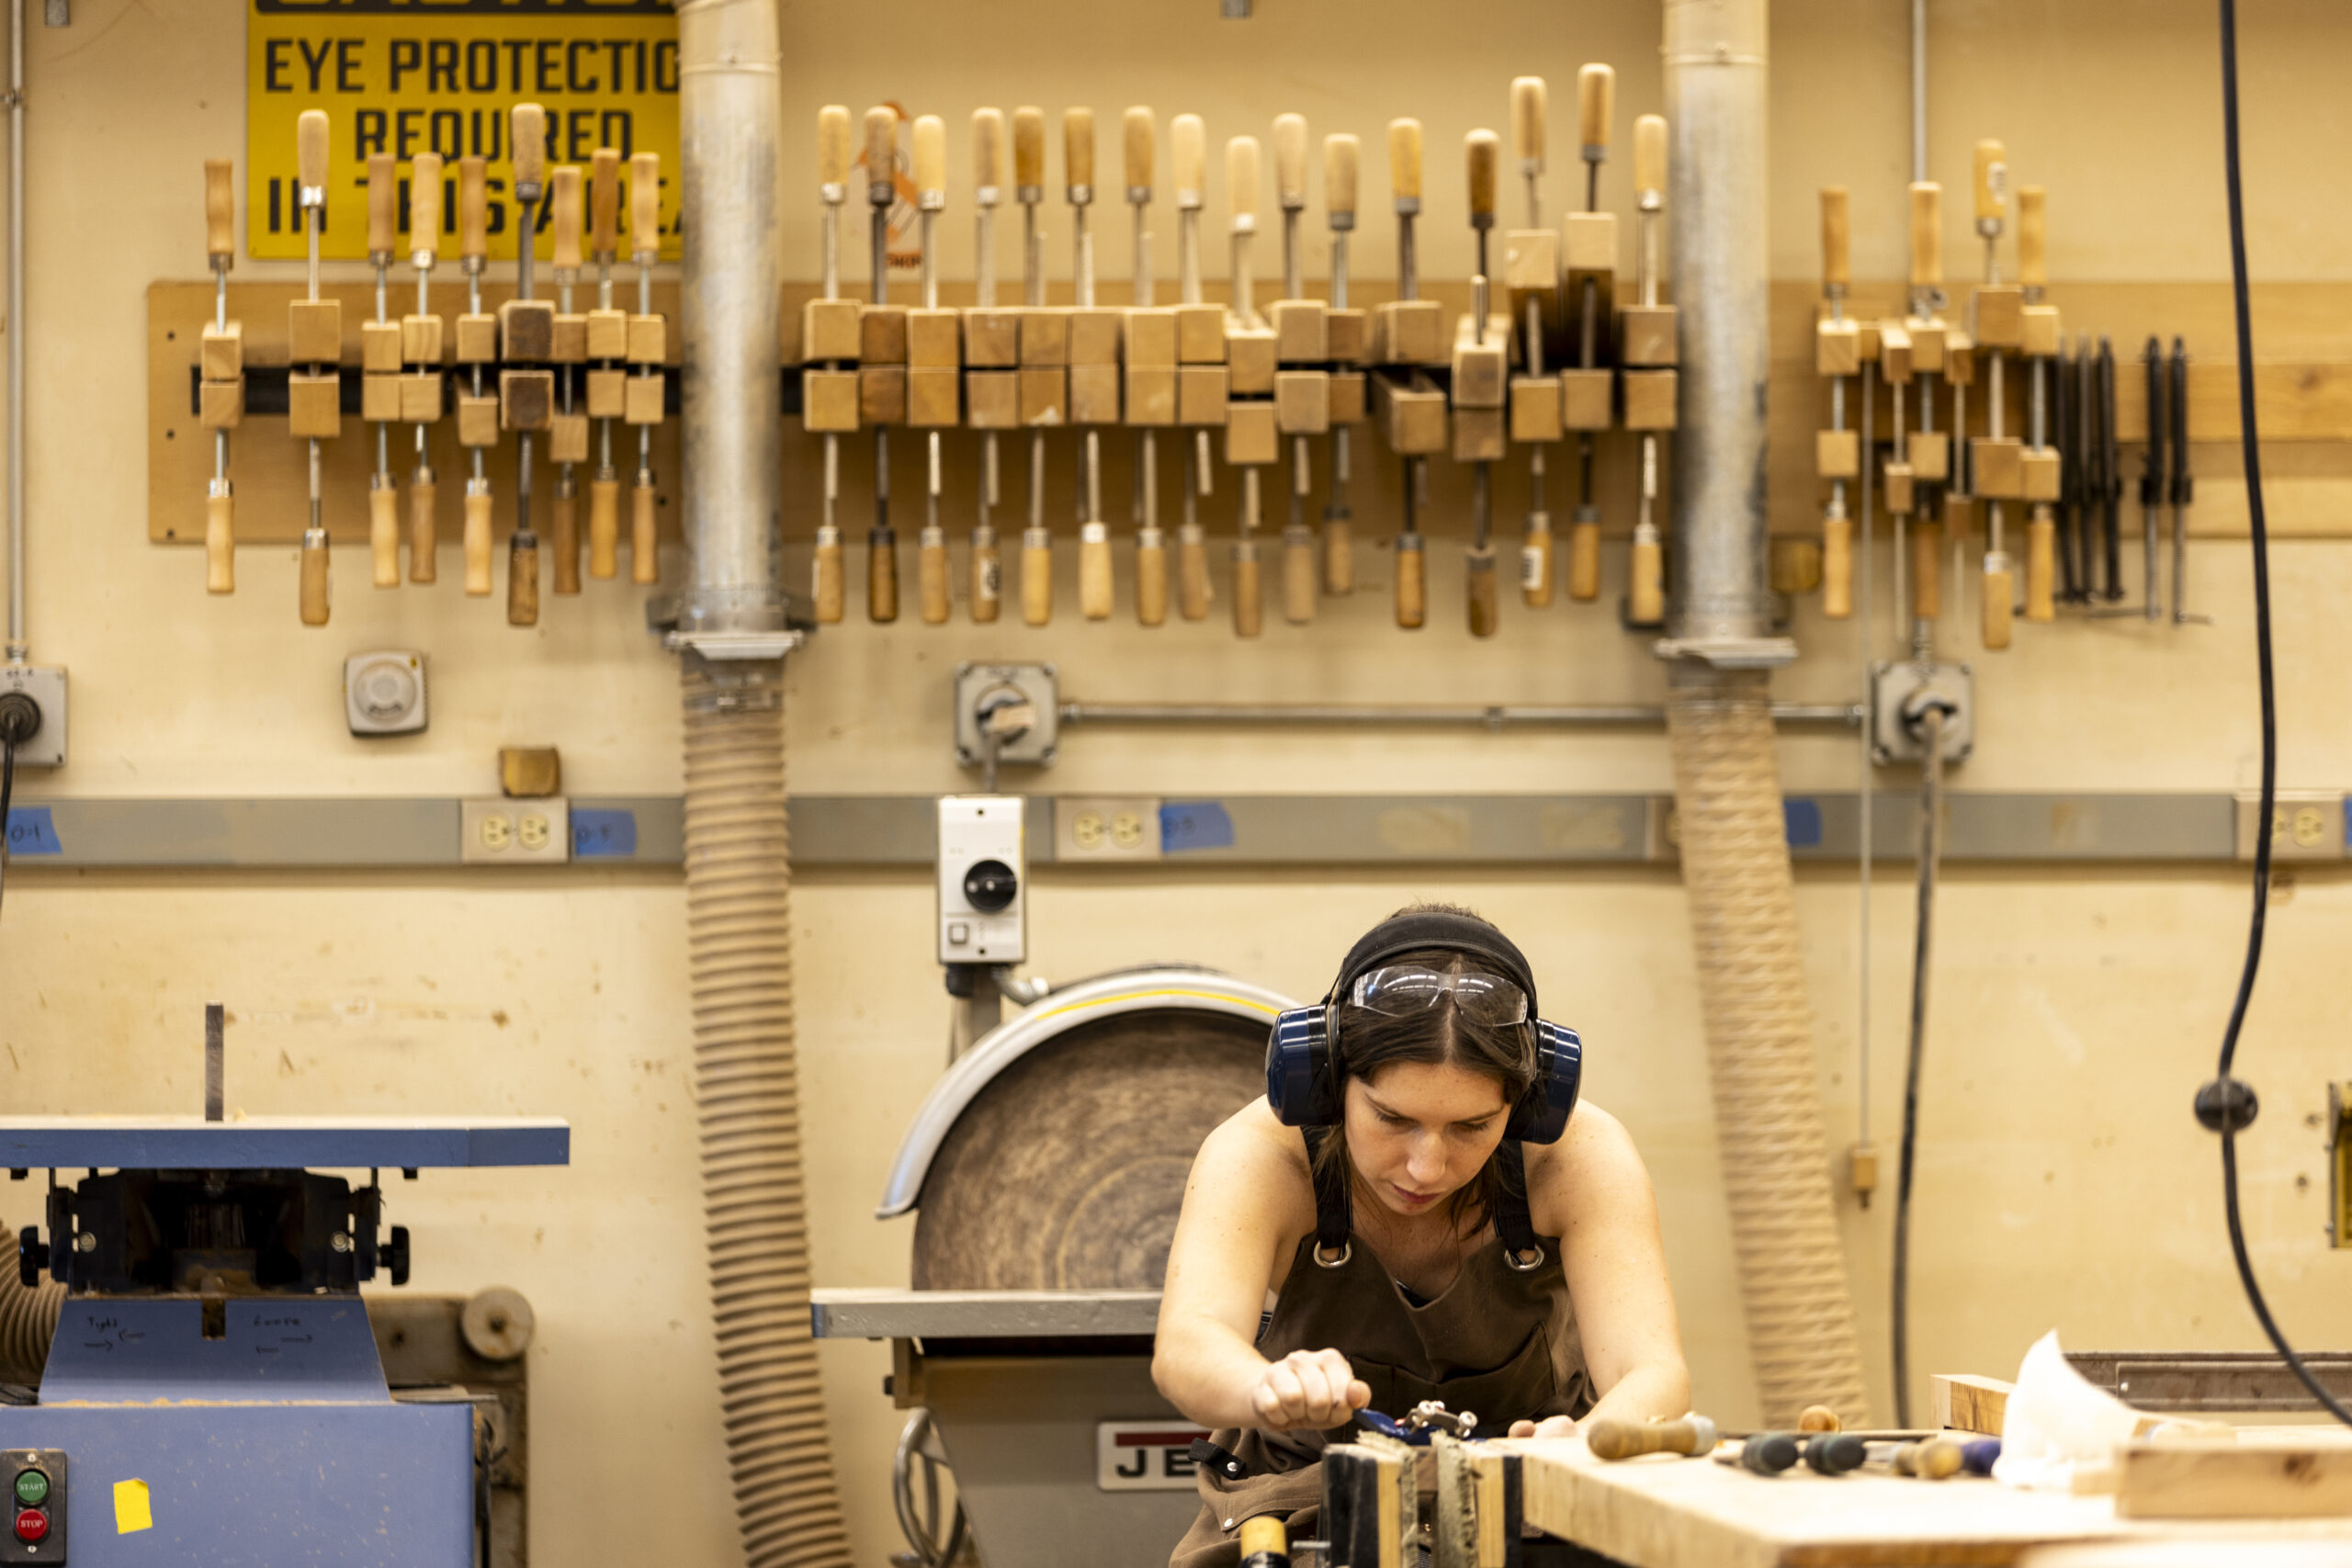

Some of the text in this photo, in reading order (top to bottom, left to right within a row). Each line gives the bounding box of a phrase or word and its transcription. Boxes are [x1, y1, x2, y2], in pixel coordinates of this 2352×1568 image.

[266, 39, 680, 93] EYE PROTECTIO
[1116, 1449, 1197, 1479] JE
[19, 1483, 44, 1492] START
[20, 1519, 43, 1529] STOP
